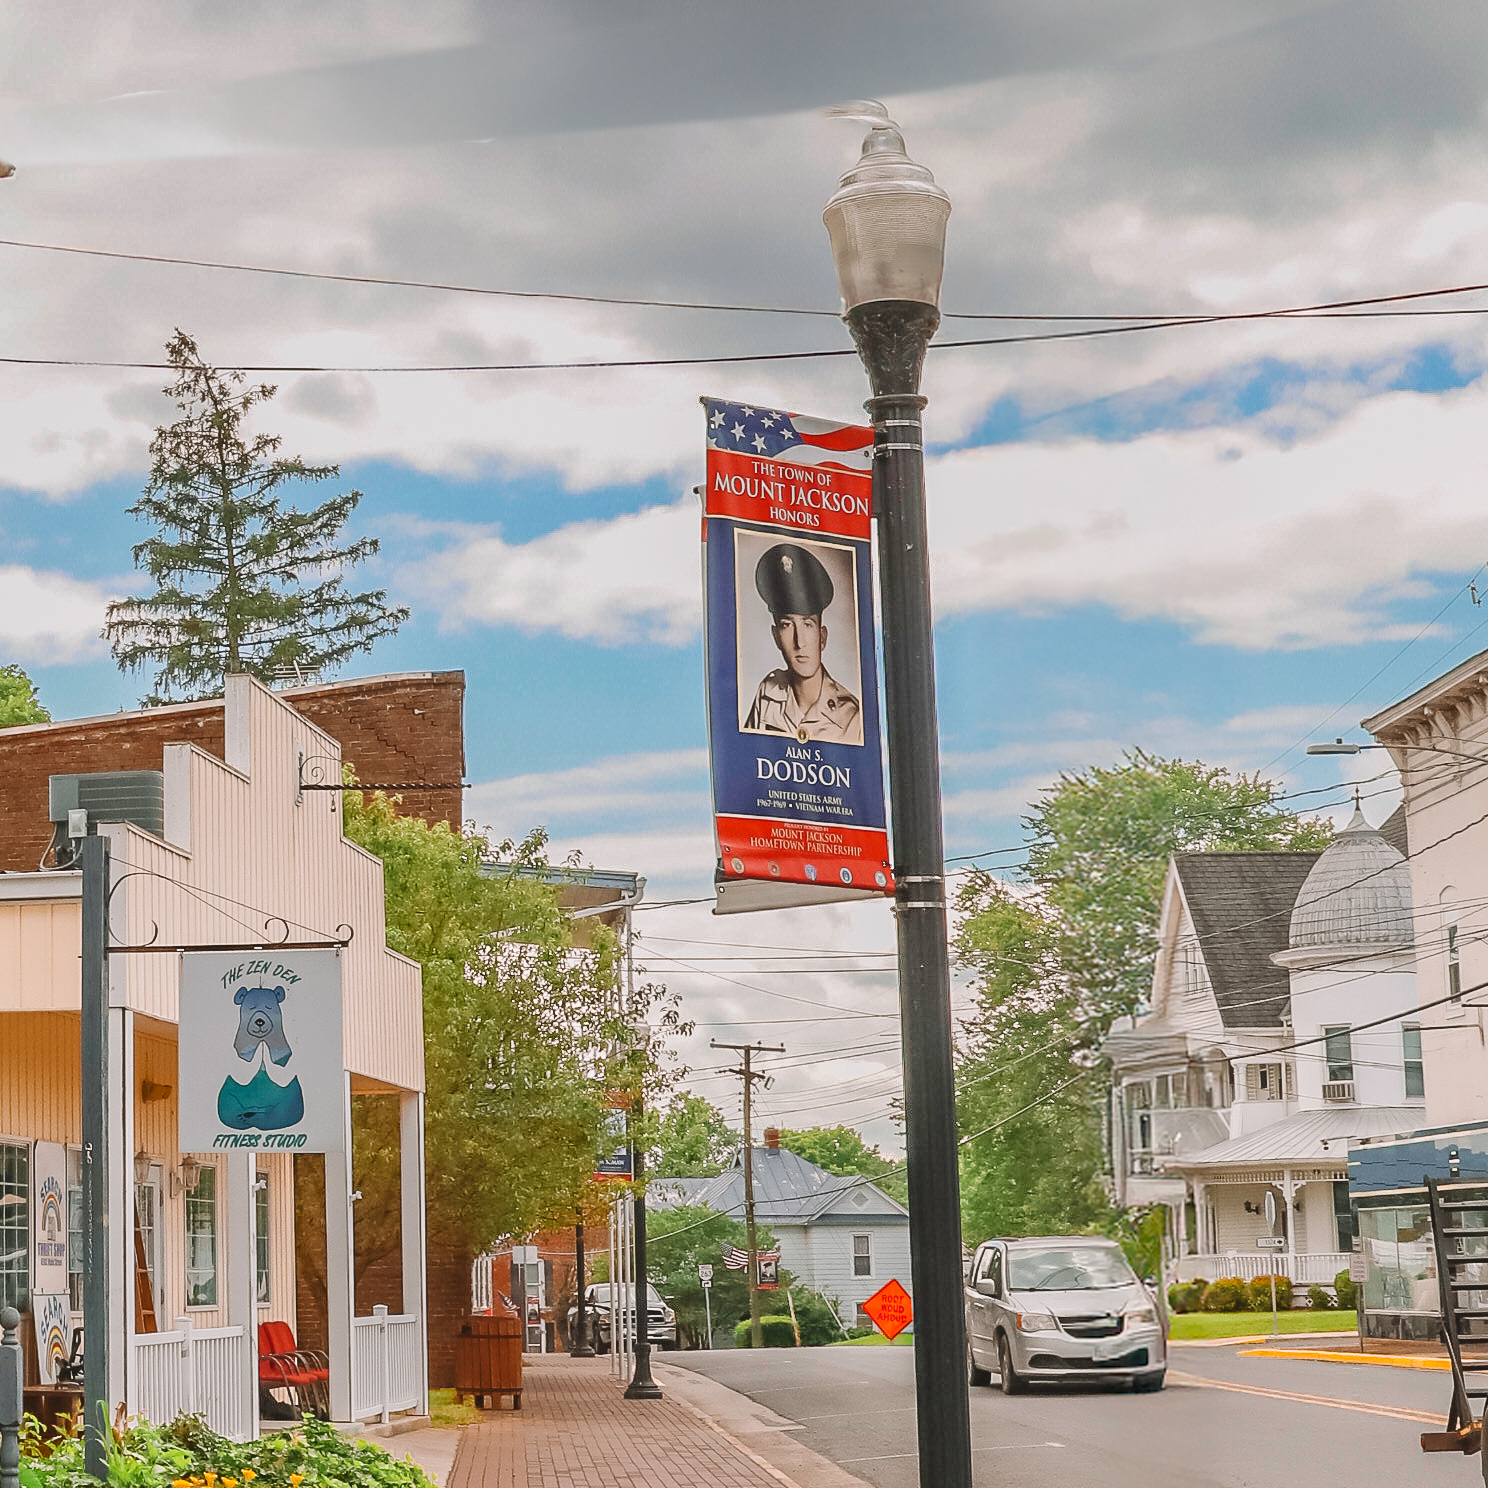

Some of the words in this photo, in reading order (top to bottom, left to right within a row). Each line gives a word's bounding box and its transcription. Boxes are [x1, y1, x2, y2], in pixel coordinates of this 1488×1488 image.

[752, 461, 775, 477] THE
[778, 466, 814, 483] TOWN
[817, 474, 831, 486] OF
[714, 472, 786, 502] MOUNT
[790, 485, 869, 516] JACKSON
[770, 507, 820, 526] HONORS
[786, 747, 811, 760] ALAN
[815, 749, 824, 761] S.
[756, 757, 851, 789] DODSON
[768, 790, 798, 801] UNITED
[799, 793, 821, 803] STATES
[822, 796, 842, 806] ARMY
[795, 802, 824, 813] VIETNAM
[825, 805, 840, 815] WAR
[842, 808, 854, 816] ERA
[771, 828, 804, 840] MOUNT
[806, 832, 843, 843] JACKSON
[750, 837, 805, 851] HOMETOWN
[807, 842, 862, 857] PARTNERSHIP
[221, 964, 244, 989] THE
[246, 960, 272, 974] ZEN
[274, 964, 302, 984] DEN
[213, 1134, 261, 1148] FITNESS
[262, 1134, 308, 1148] STUDIO
[41, 1296, 68, 1344] SEARCH
